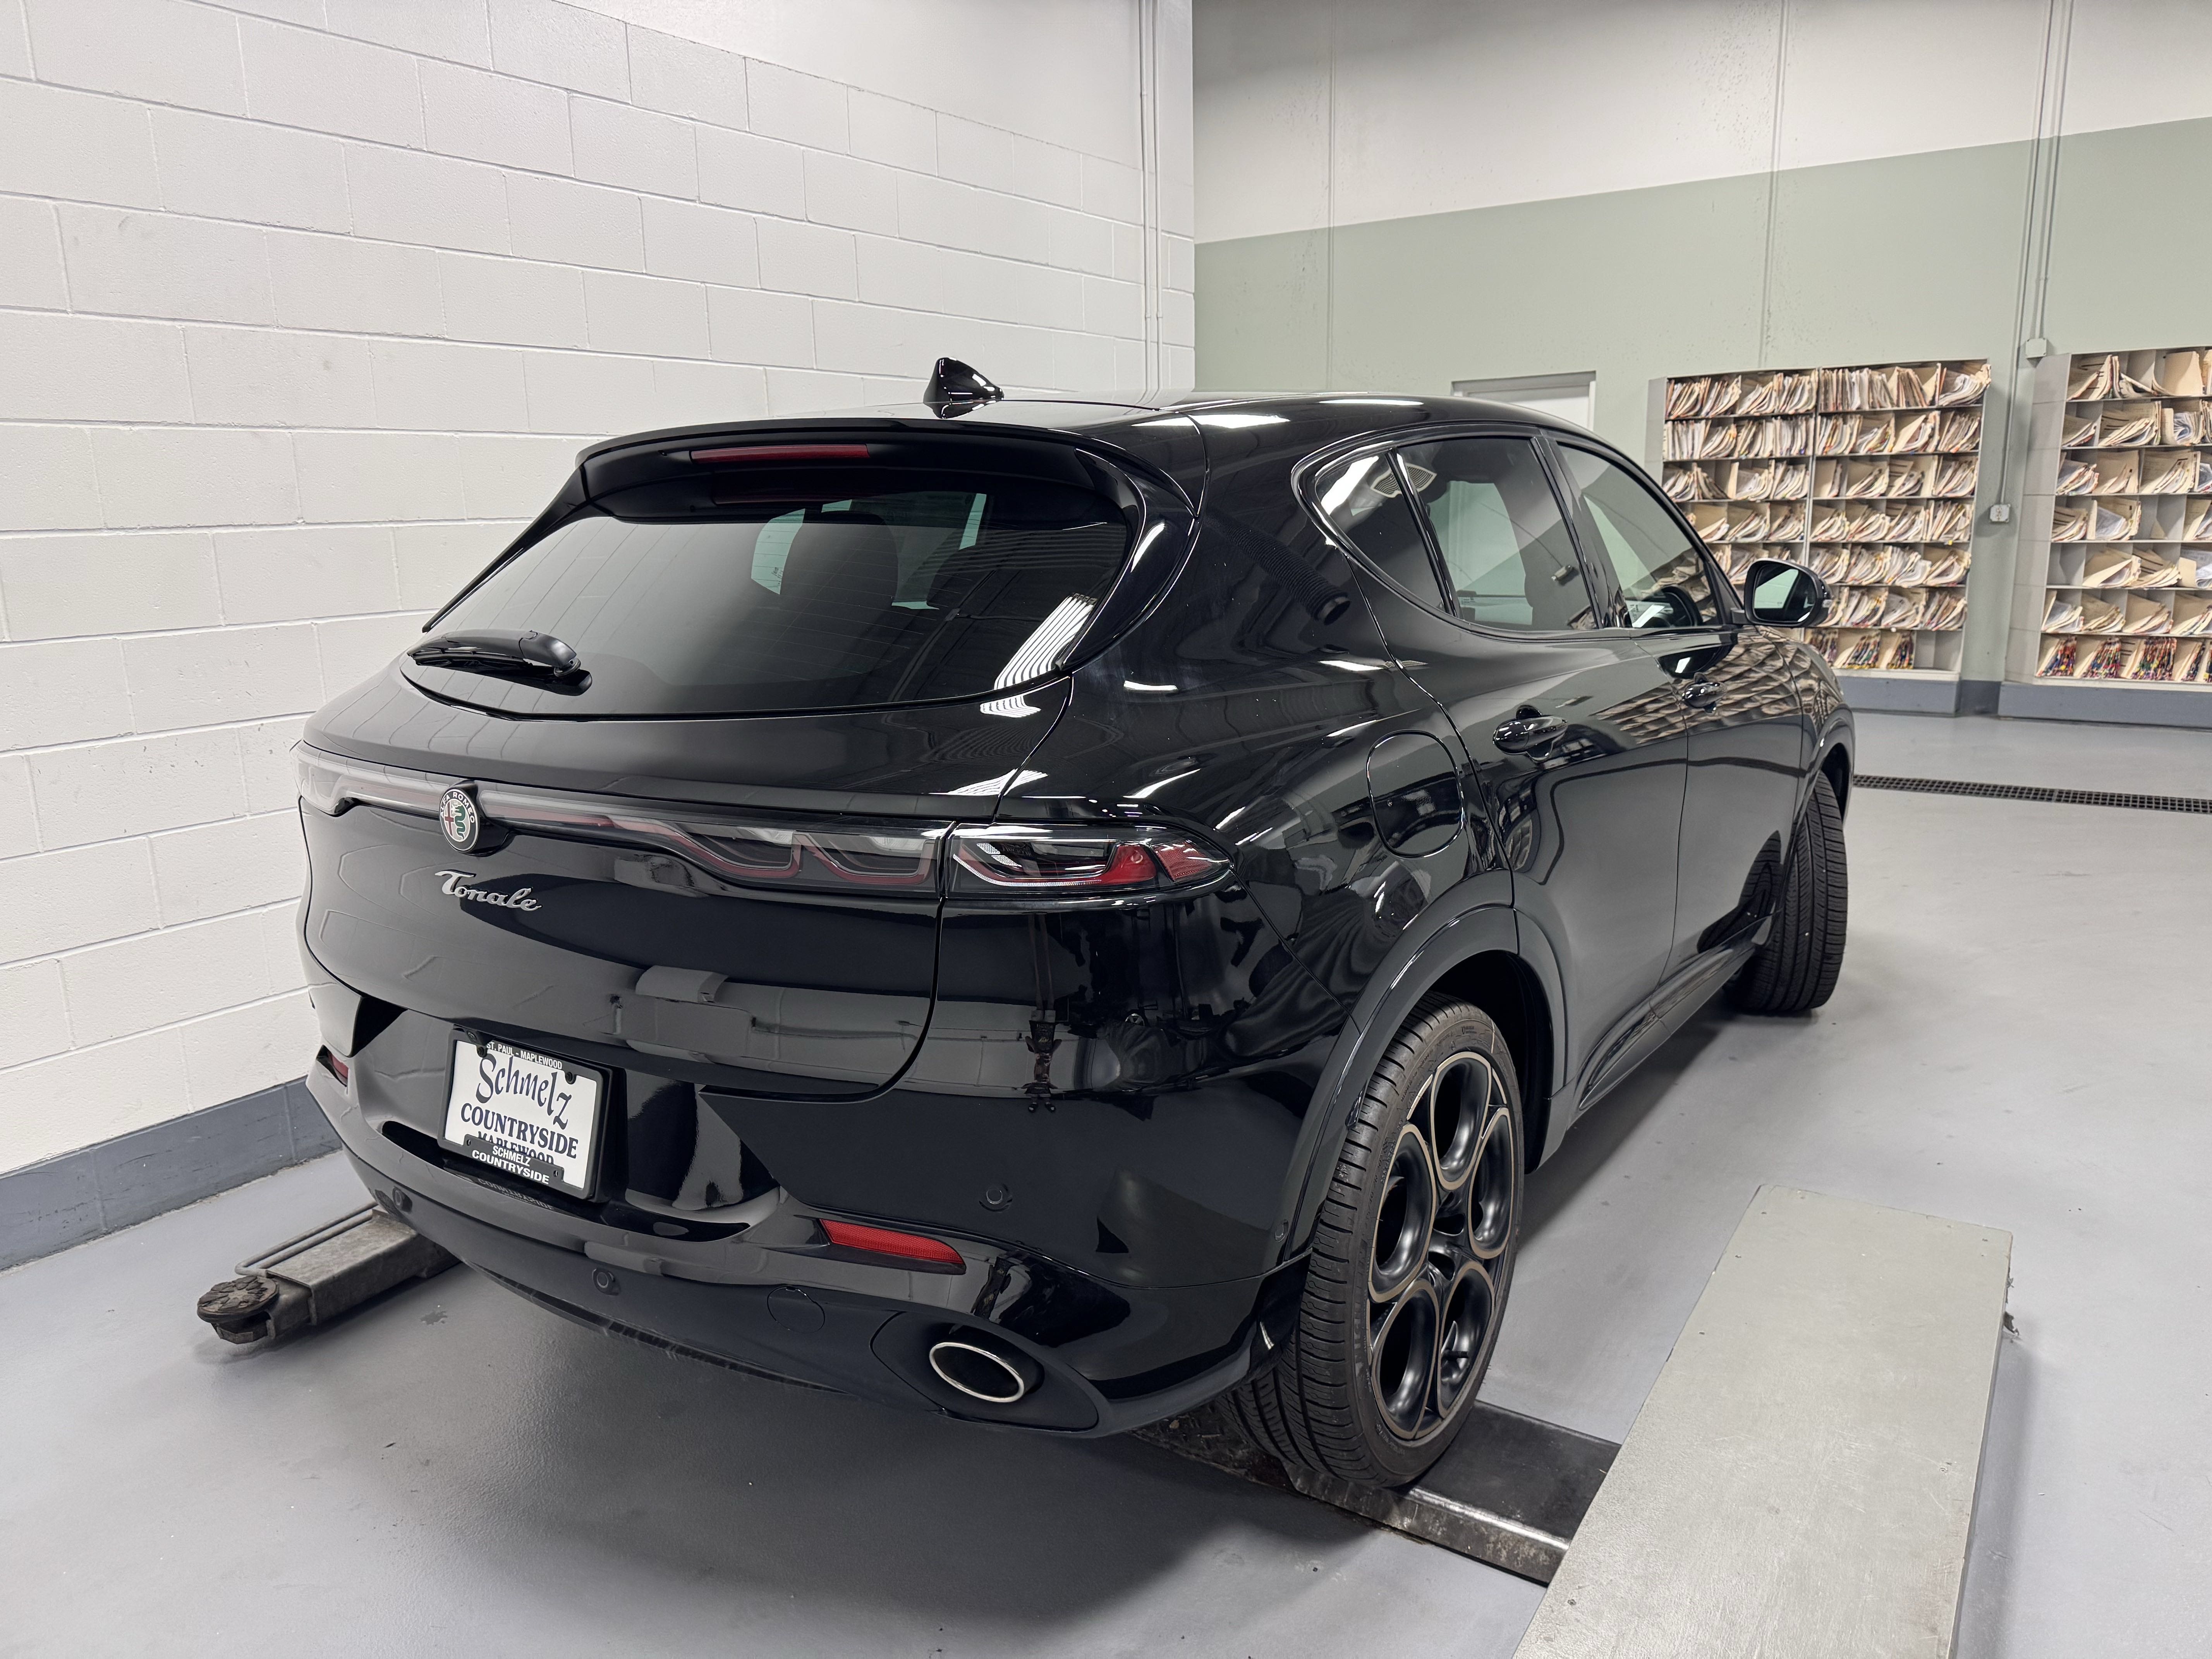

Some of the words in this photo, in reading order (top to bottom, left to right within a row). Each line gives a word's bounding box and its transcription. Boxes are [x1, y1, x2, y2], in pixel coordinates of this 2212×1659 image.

[441, 794, 450, 818] ALFA
[453, 792, 475, 823] ROMEO
[435, 869, 542, 911] Tonale
[487, 1041, 496, 1051] ST.
[498, 1043, 514, 1056] PAUL
[520, 1050, 562, 1070] MAPLEWOOD
[461, 1103, 579, 1159] COUNTRYSIDE
[472, 1149, 550, 1185] COUNTRYSIDE
[492, 1145, 531, 1167] SCHMELZ
